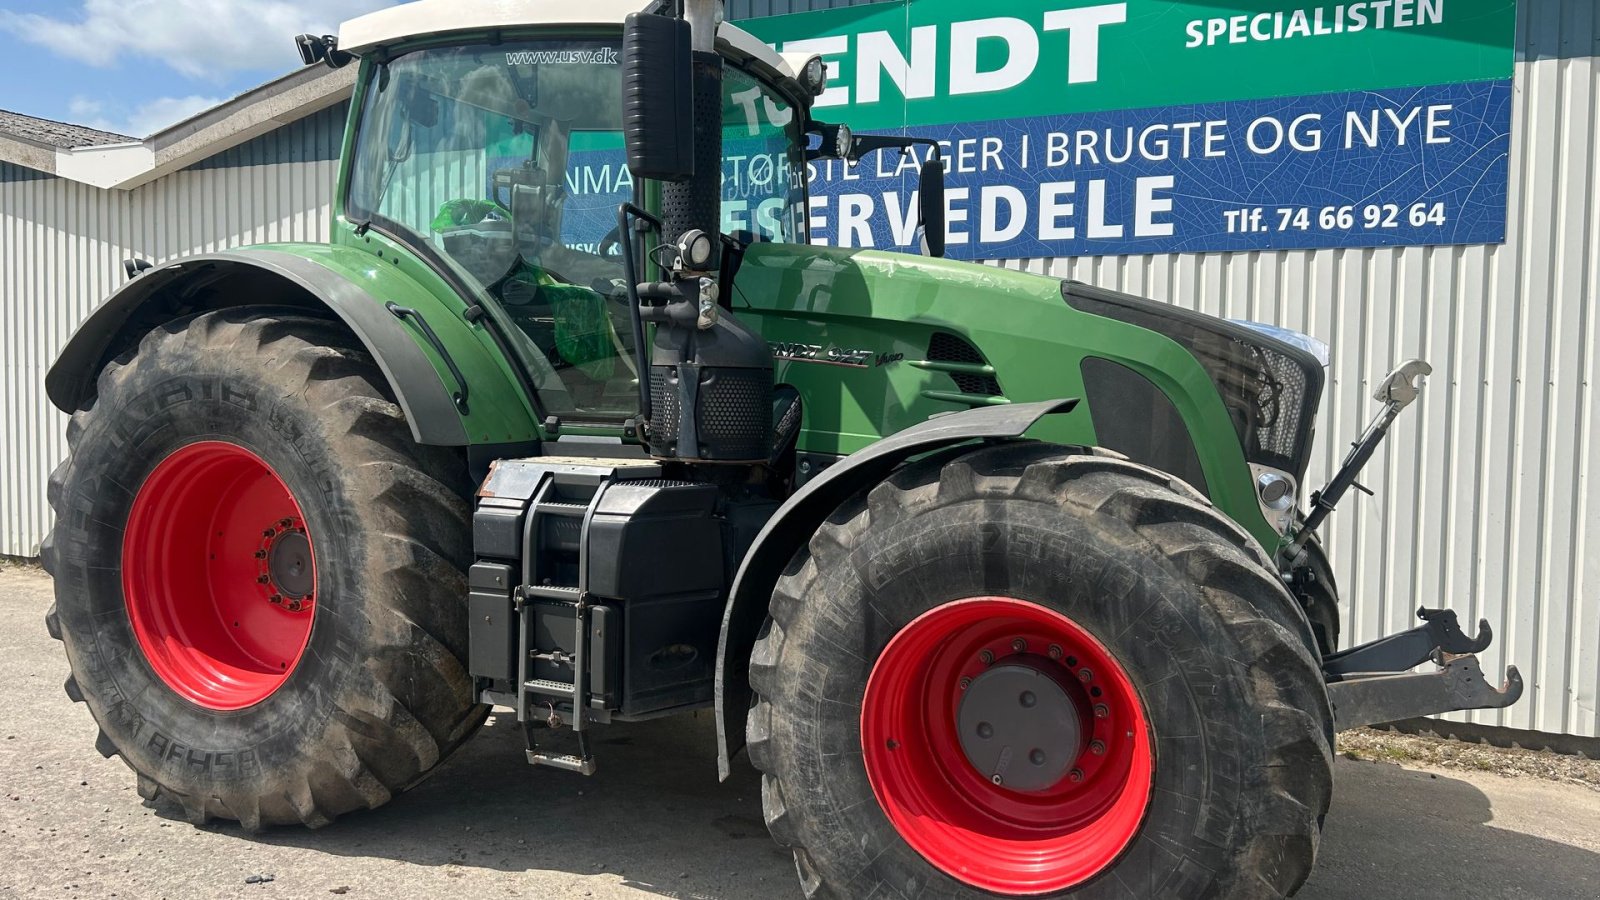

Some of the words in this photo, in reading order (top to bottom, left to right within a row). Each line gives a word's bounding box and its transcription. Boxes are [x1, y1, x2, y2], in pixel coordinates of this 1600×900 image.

[1185, 0, 1444, 48] SPECIALISTEN
[506, 47, 617, 65] www.usv.dk
[768, 4, 1127, 108] ENDT
[876, 138, 1004, 179] LAGER
[1021, 134, 1029, 169] I
[1046, 119, 1227, 168] BRUGTE
[1245, 112, 1323, 155] OG
[1344, 103, 1453, 150] NYE
[720, 174, 1175, 249] ESERVEDELE
[1223, 208, 1266, 233] Tlf.
[1276, 207, 1310, 232] 74
[1318, 205, 1354, 230] 66
[1362, 203, 1399, 229] 92
[1407, 201, 1446, 227] 64
